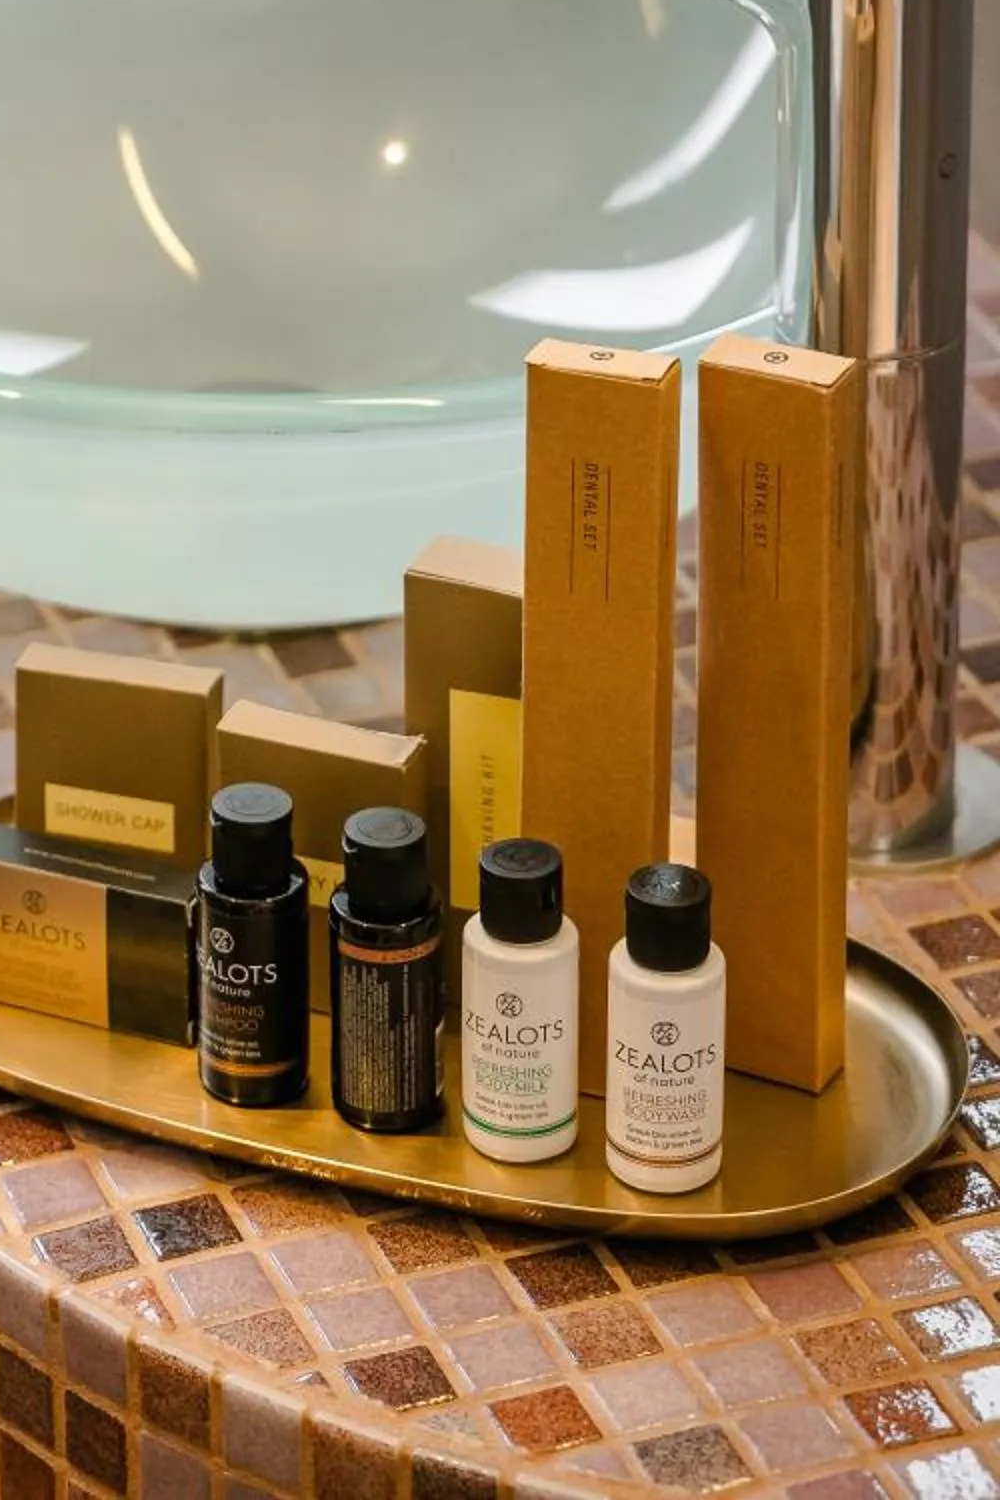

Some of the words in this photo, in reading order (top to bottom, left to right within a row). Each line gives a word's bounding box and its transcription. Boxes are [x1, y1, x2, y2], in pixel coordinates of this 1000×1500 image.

[583, 461, 599, 517] DENTAL
[753, 461, 769, 517] DENTAL
[583, 523, 598, 551] SET
[752, 523, 768, 549] SET
[55, 800, 126, 828] SHOWER
[131, 814, 167, 836] CAP
[465, 1011, 564, 1046] ZEALOTS
[495, 1047, 542, 1061] nature
[615, 1040, 717, 1074] ZEALOTS
[633, 1072, 648, 1083] of
[650, 1075, 696, 1088] nature
